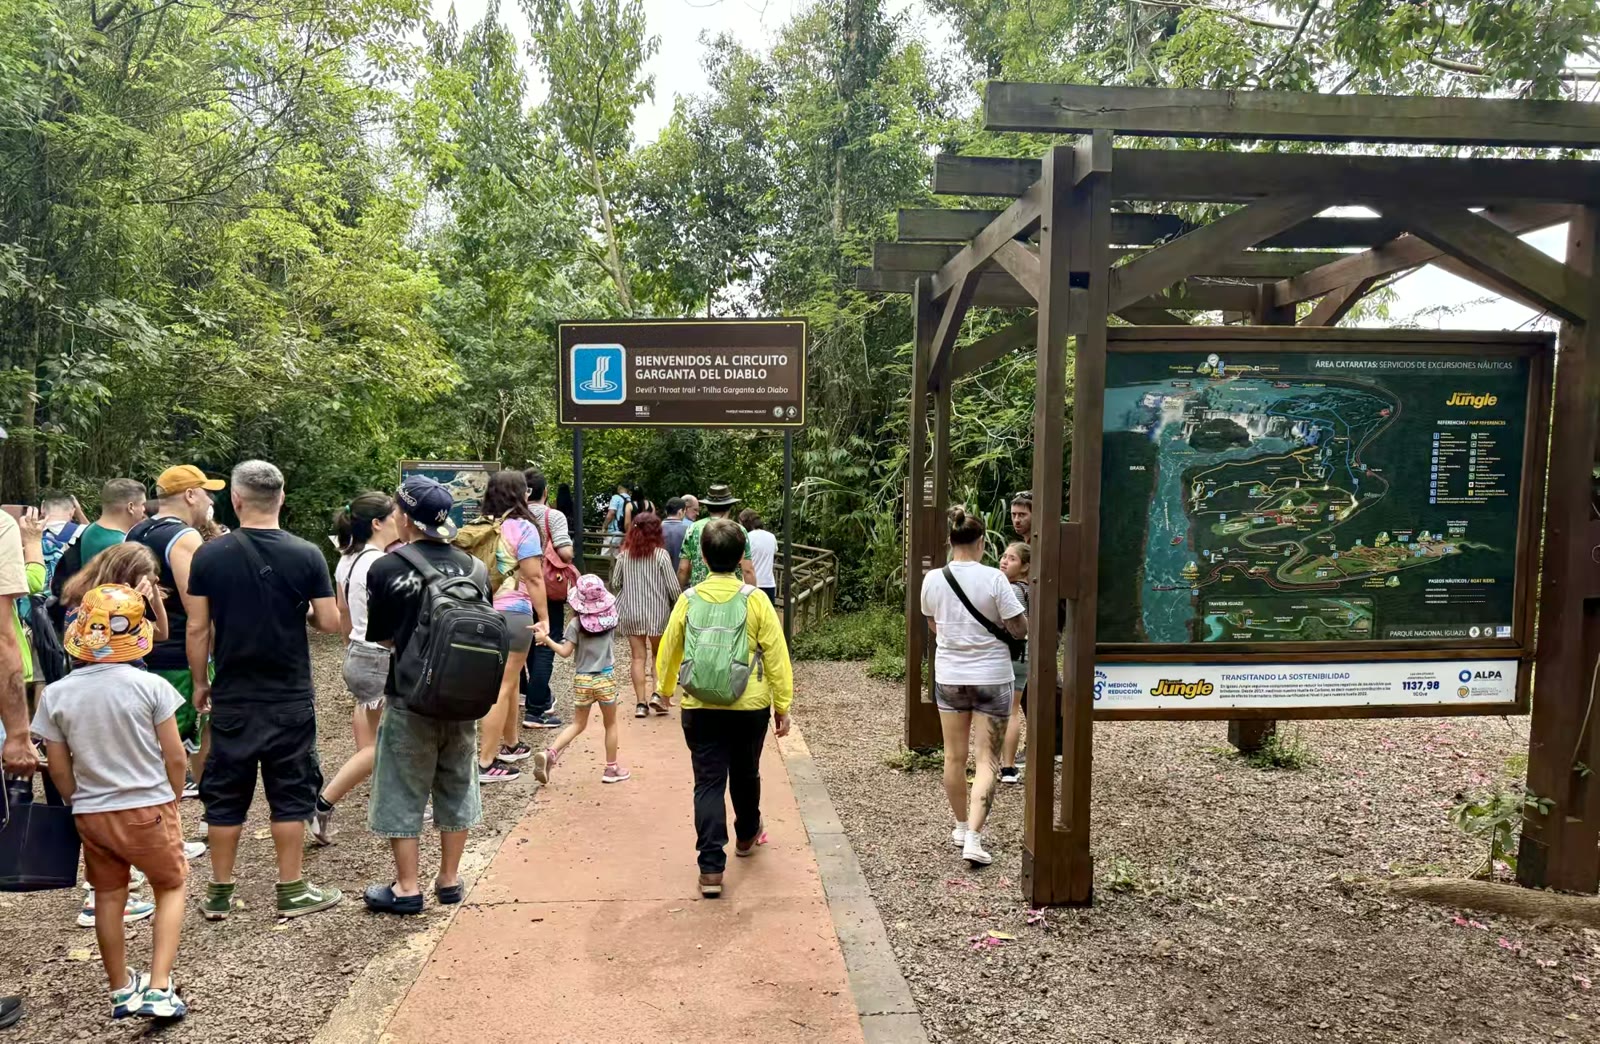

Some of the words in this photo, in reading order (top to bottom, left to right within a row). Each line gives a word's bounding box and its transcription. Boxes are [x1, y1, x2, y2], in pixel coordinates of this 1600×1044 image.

[635, 356, 712, 366] BIENVENIDOS
[714, 356, 729, 366] AL
[732, 354, 788, 366] CIRCUITO
[1316, 360, 1334, 368] ÁREA
[1380, 361, 1416, 369] SERVICIOS
[1428, 362, 1476, 370] EXCURSIONES
[1478, 360, 1512, 370] NÁUTICAS
[635, 369, 696, 380] GARGANTA
[700, 369, 722, 380] DEL
[724, 369, 767, 380] DIABLO
[635, 386, 657, 394] Devil's
[658, 386, 680, 394] Throat
[682, 386, 696, 394] trail
[702, 386, 722, 394] Trilha
[723, 386, 754, 396] Garganta
[756, 386, 766, 394] do
[767, 386, 789, 394] Diabo
[1446, 392, 1498, 408] Jungle
[1474, 670, 1502, 679] ALPA
[1150, 679, 1214, 699] Jungle
[1402, 681, 1440, 691] 1137,98
